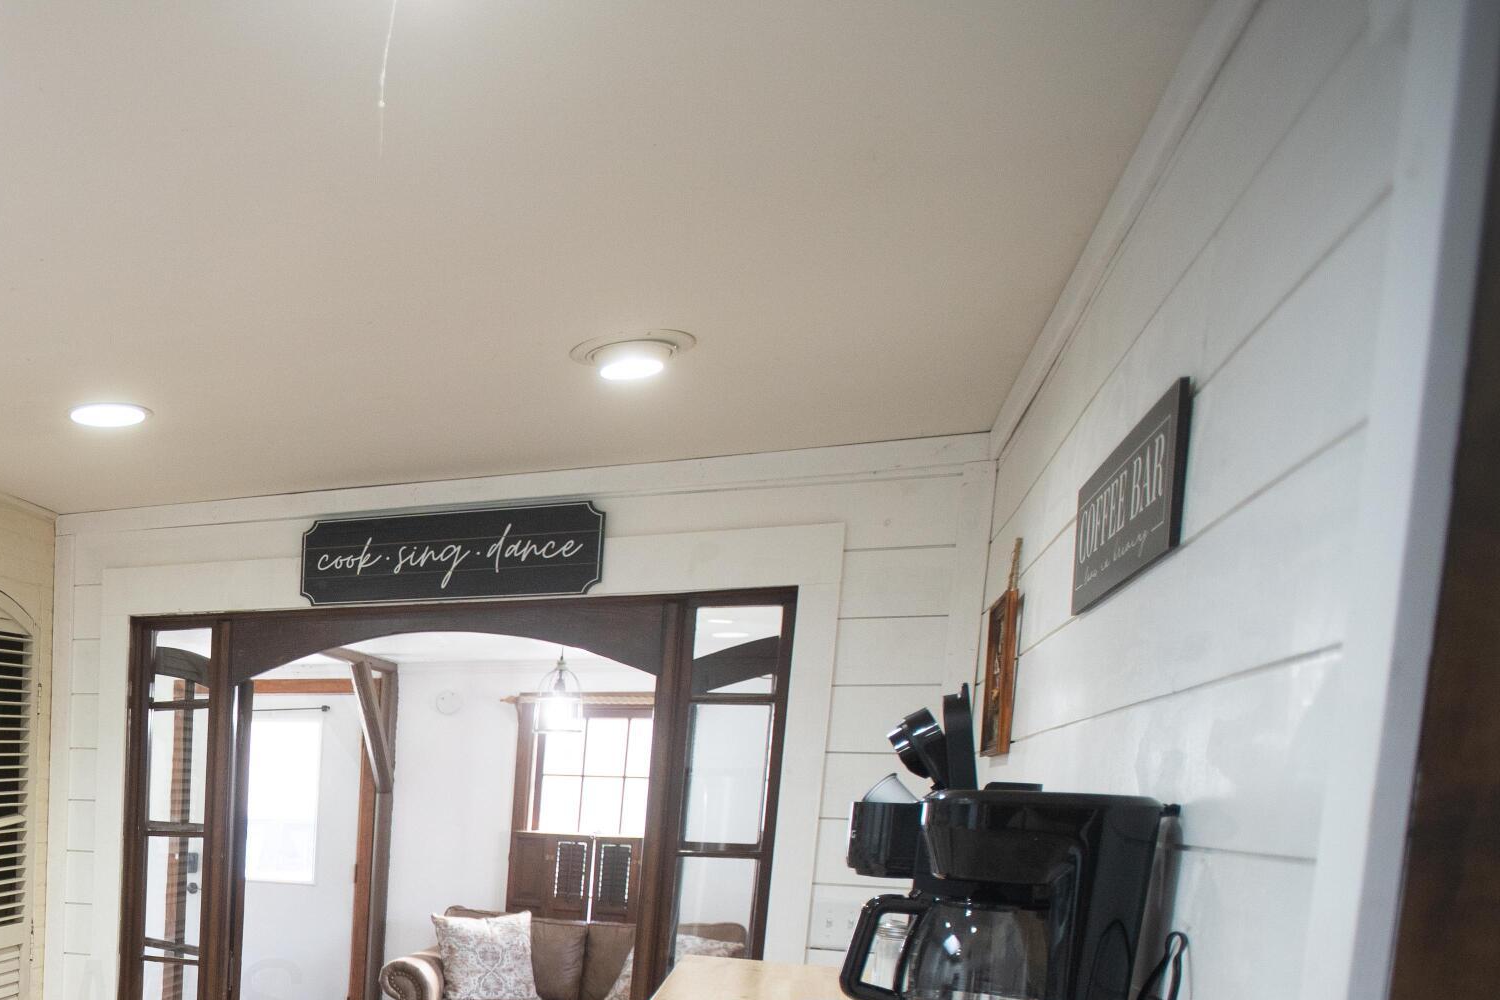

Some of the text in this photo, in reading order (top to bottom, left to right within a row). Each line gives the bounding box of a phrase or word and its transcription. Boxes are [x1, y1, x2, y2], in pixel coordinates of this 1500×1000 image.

[1078, 469, 1128, 565] COFFEE
[1129, 433, 1166, 521] BAR
[317, 523, 584, 589] cook sing dance
